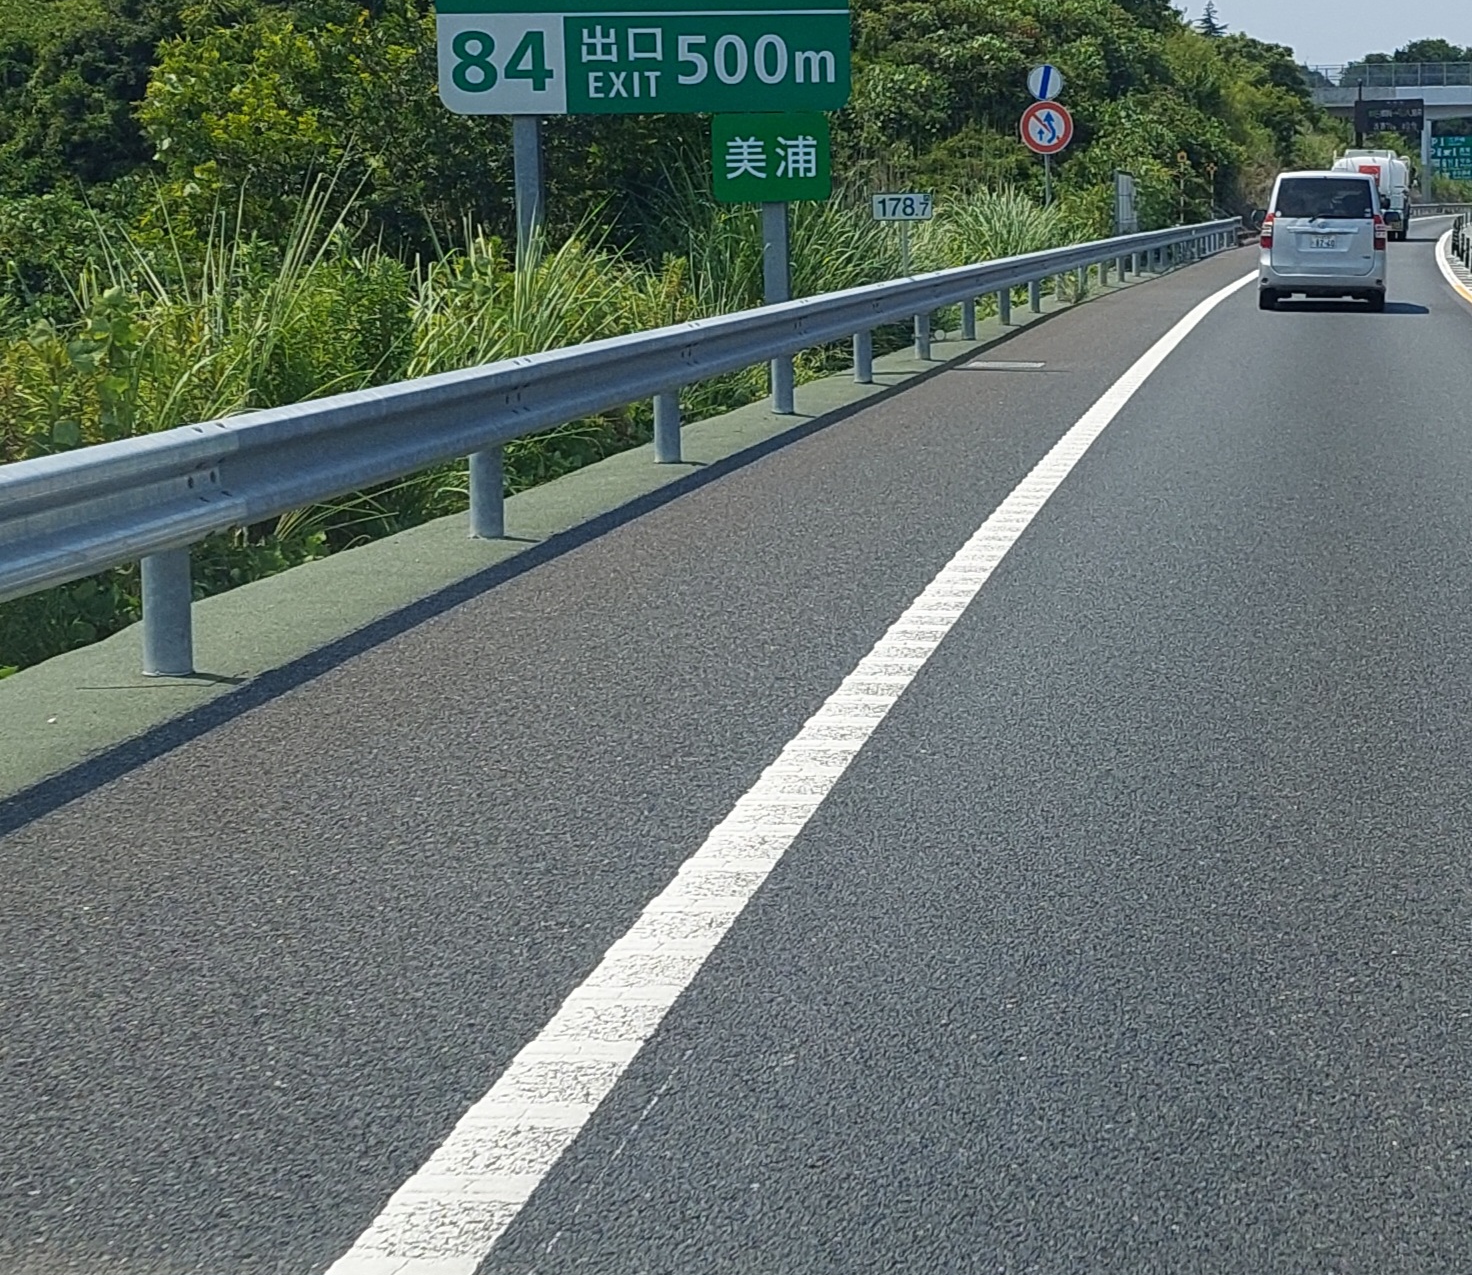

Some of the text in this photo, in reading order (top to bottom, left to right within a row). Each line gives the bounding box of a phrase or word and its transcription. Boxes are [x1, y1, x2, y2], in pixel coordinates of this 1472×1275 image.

[451, 30, 554, 94] 84
[581, 25, 663, 62] 出口
[678, 34, 836, 85] 500m
[588, 71, 661, 98] EXIT
[725, 135, 818, 179] 美浦
[877, 197, 929, 217] 178.7
